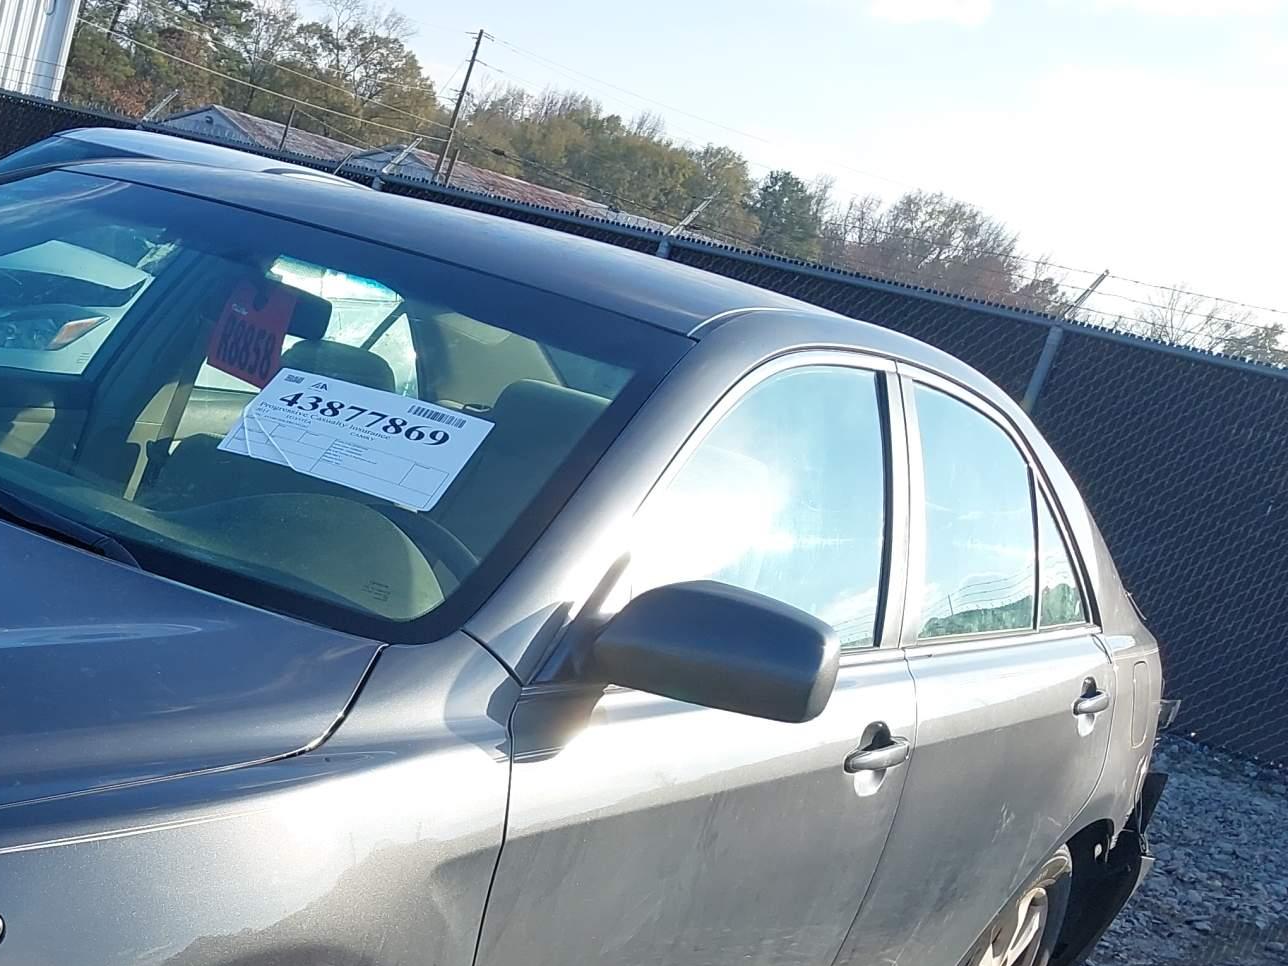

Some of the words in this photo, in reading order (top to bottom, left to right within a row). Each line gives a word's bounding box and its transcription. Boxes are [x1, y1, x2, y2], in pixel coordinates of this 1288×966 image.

[260, 401, 309, 418] Progressive
[311, 413, 346, 428] Casualty
[350, 424, 391, 440] Insurance
[279, 392, 450, 446] 43877869
